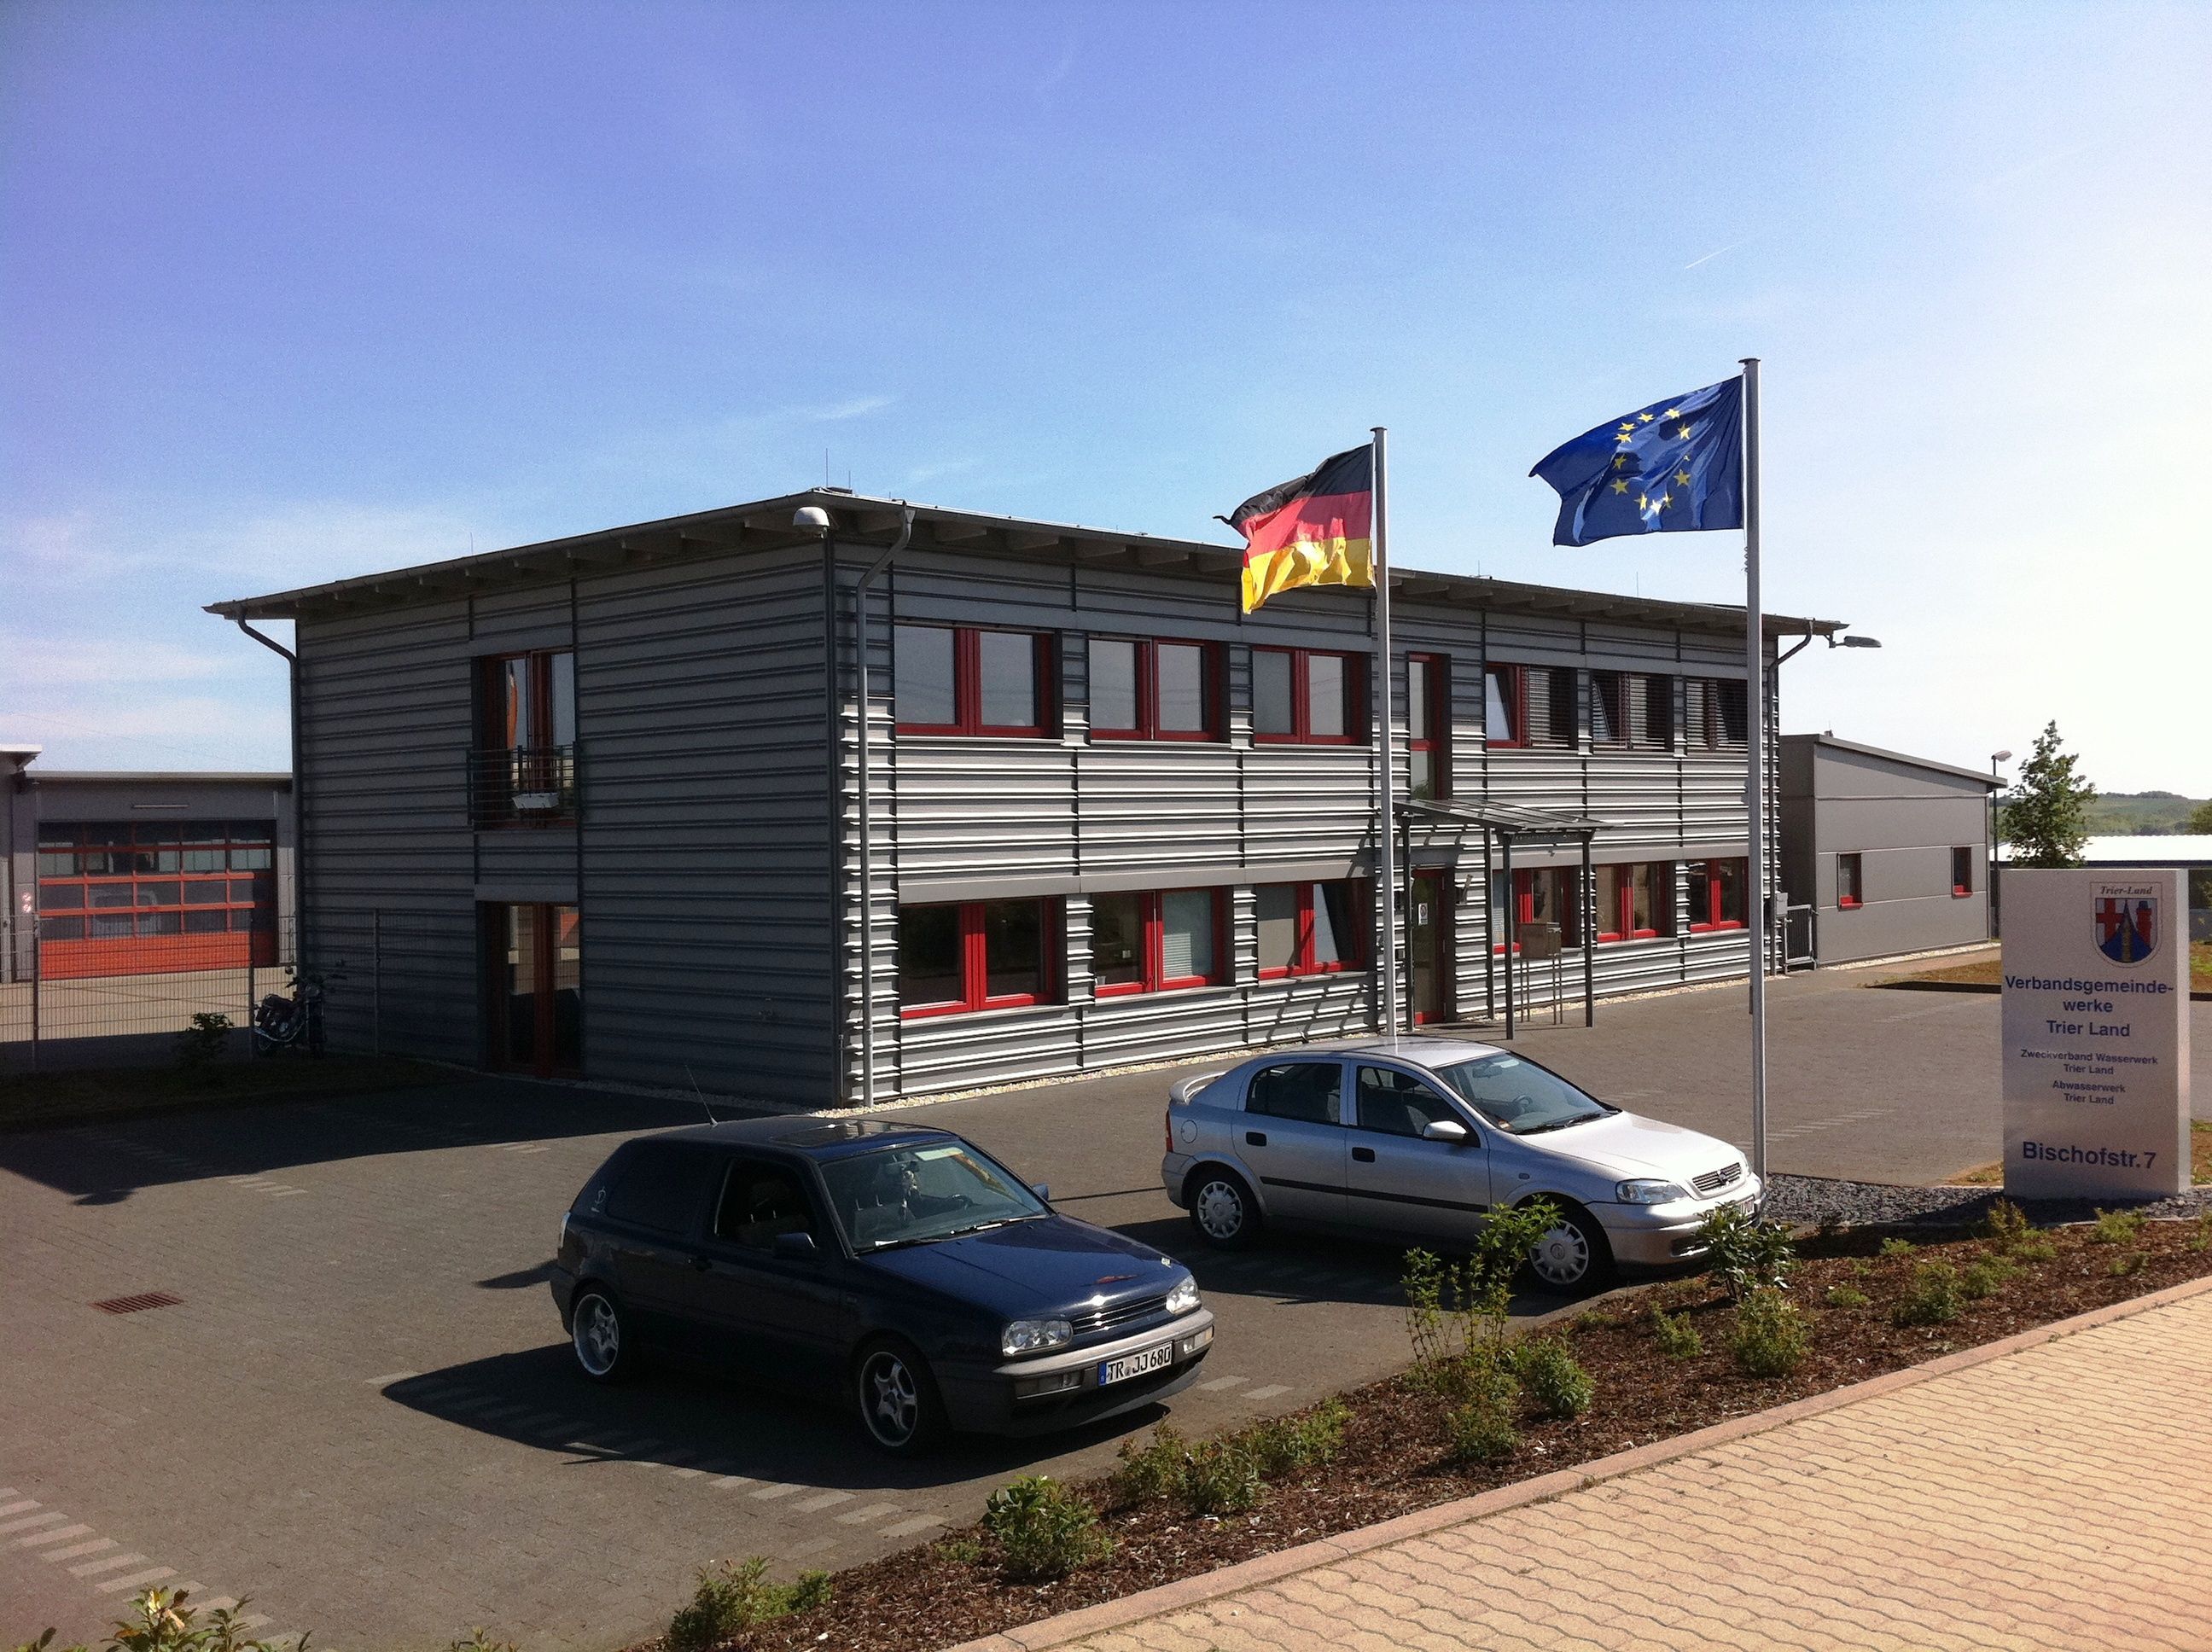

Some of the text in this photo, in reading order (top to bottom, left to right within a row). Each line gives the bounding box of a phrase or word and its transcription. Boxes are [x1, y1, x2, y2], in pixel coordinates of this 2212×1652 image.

[2100, 886, 2153, 895] Trier-Land
[2005, 975, 2174, 994] Verbandsgemeinde-
[2063, 999, 2113, 1012] werke
[2046, 1021, 2130, 1037] Trier Land
[2020, 1049, 2158, 1065] Zweckverband Wasserwerk
[2064, 1064, 2114, 1075] Trier Land
[2052, 1080, 2126, 1093] Abwasserwerk
[2064, 1093, 2115, 1105] Trier Land
